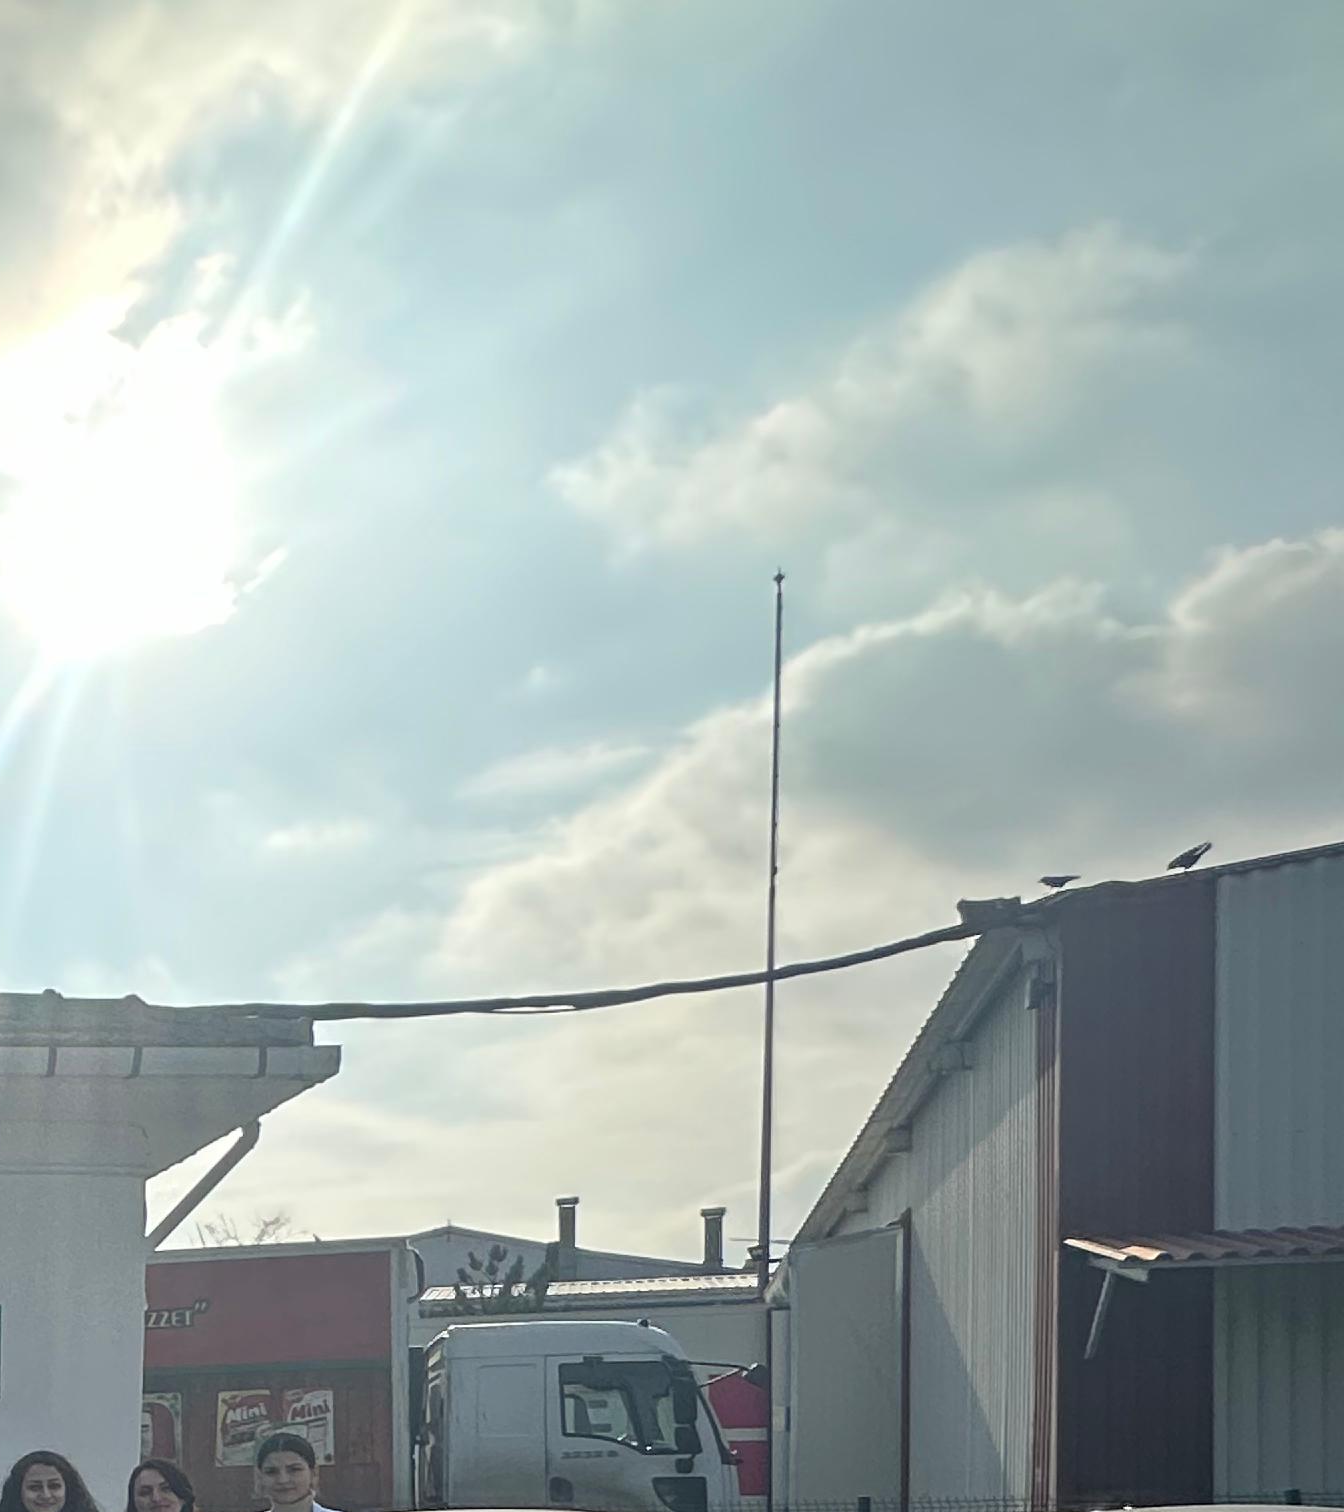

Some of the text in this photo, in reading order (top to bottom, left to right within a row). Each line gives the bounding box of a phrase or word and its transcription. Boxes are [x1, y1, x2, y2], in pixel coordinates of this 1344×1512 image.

[146, 1301, 207, 1328] ZZET"
[224, 1402, 269, 1424] Mini
[290, 1399, 332, 1422] Mini
